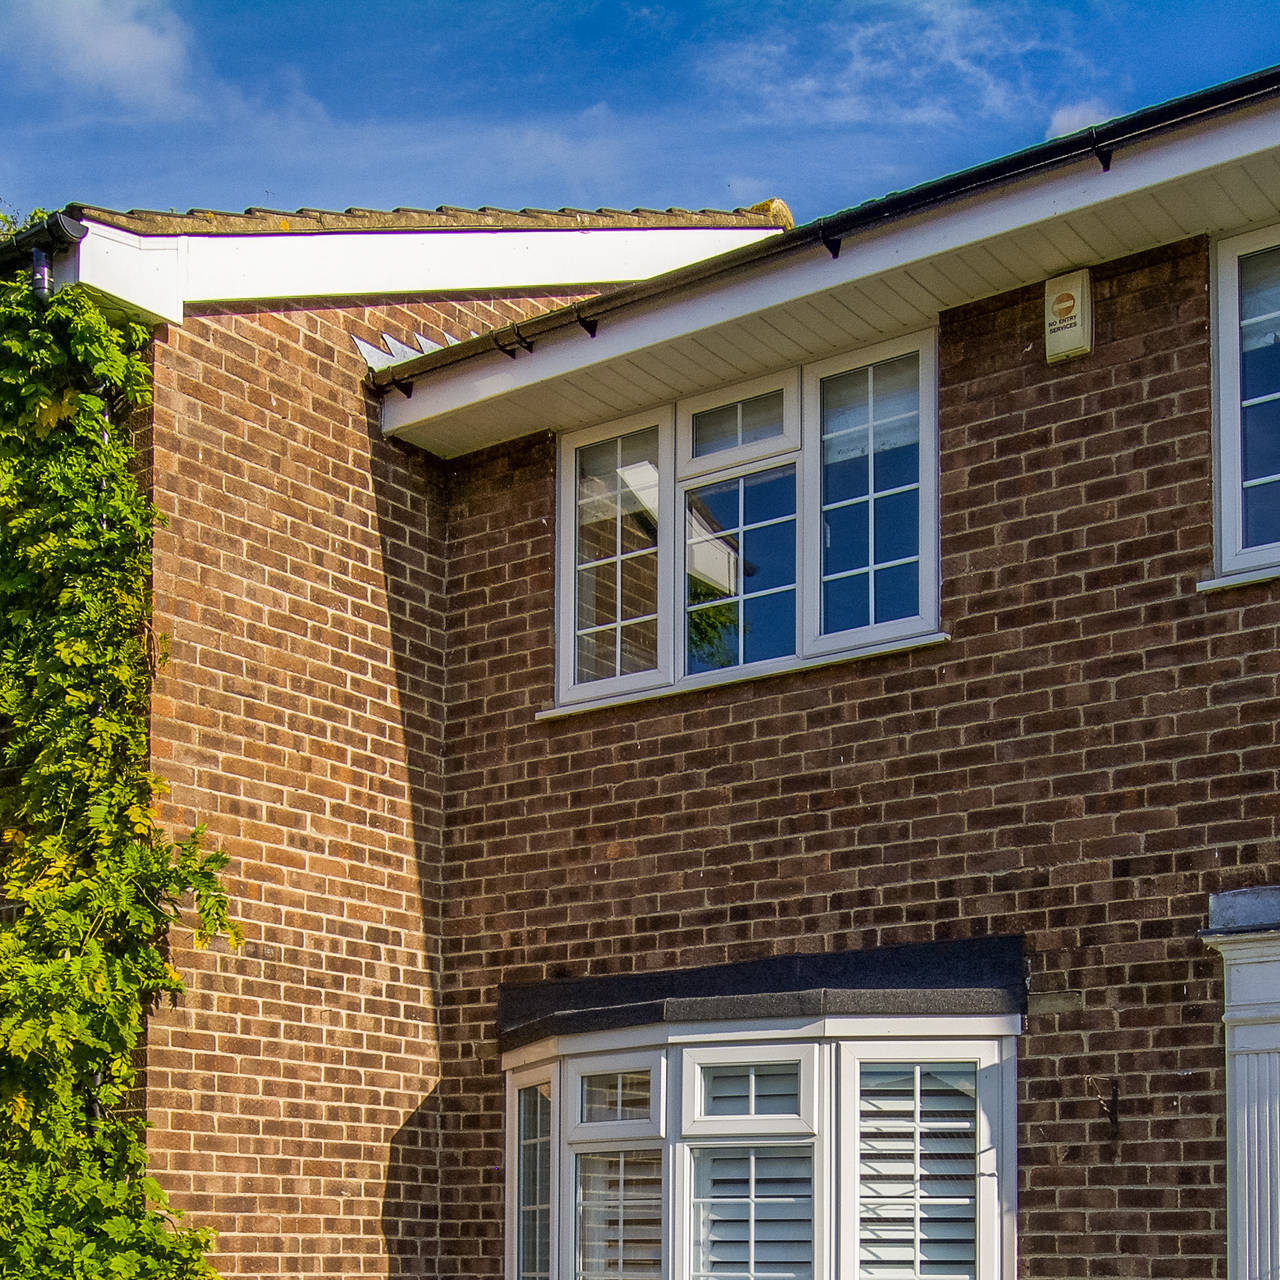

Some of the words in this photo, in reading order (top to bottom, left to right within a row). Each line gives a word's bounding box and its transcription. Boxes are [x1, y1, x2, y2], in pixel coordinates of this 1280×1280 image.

[1048, 320, 1057, 328] NO
[1059, 314, 1077, 324] ENTRY
[1049, 321, 1077, 335] SERVICES
